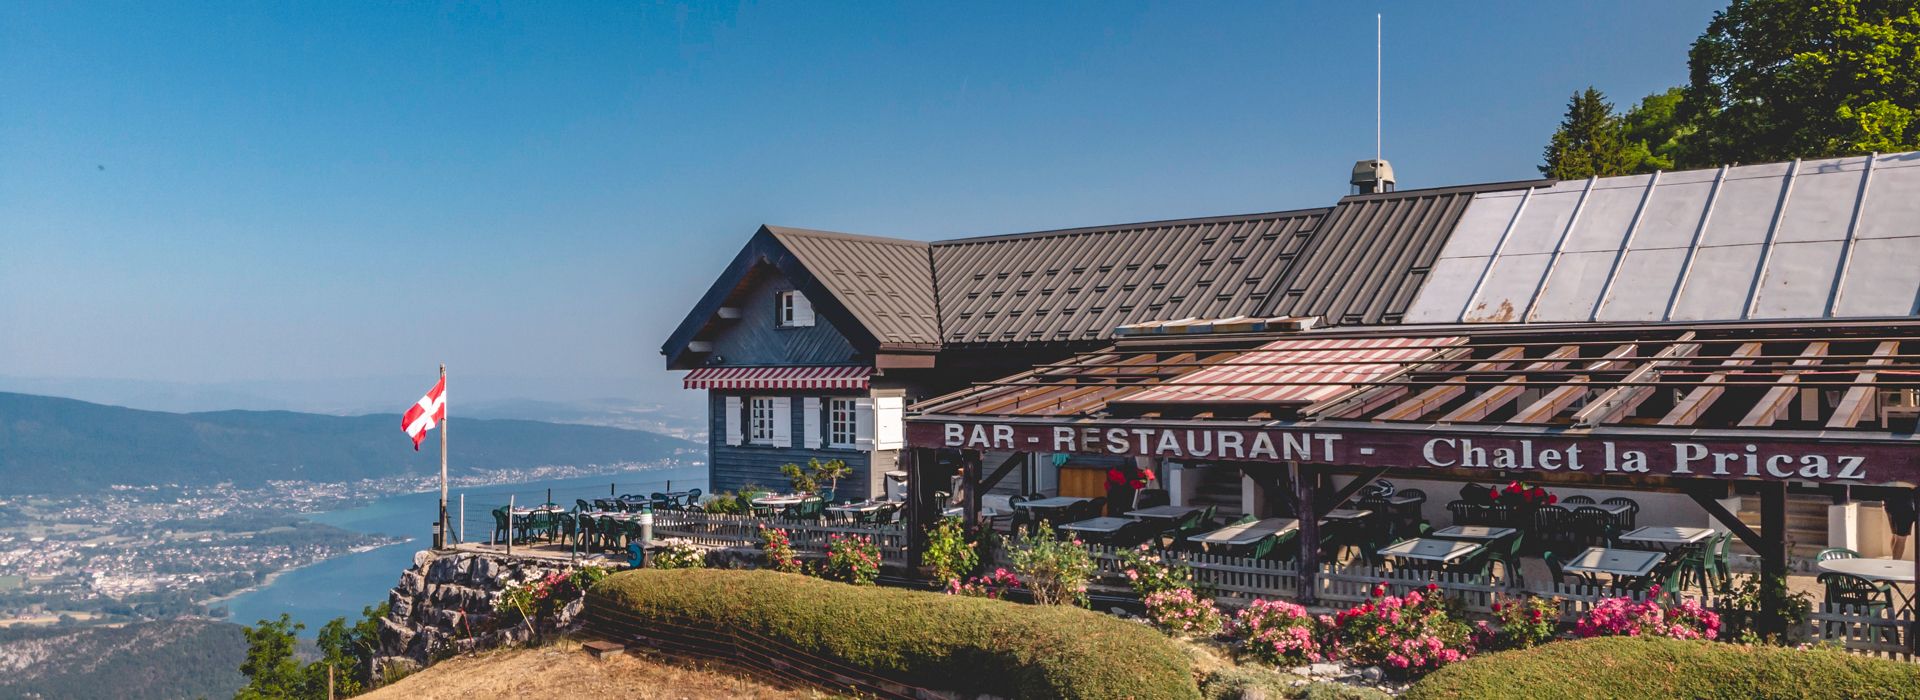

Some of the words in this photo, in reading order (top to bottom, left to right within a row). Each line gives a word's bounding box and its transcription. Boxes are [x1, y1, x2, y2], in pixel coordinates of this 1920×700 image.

[944, 423, 1015, 449] BAR
[1027, 436, 1040, 444] -
[1053, 426, 1343, 462] RESTAURANT
[1359, 447, 1376, 455] -
[1422, 437, 1585, 472] Chalet
[1602, 441, 1650, 474] la
[1671, 442, 1867, 480] Pricaz
